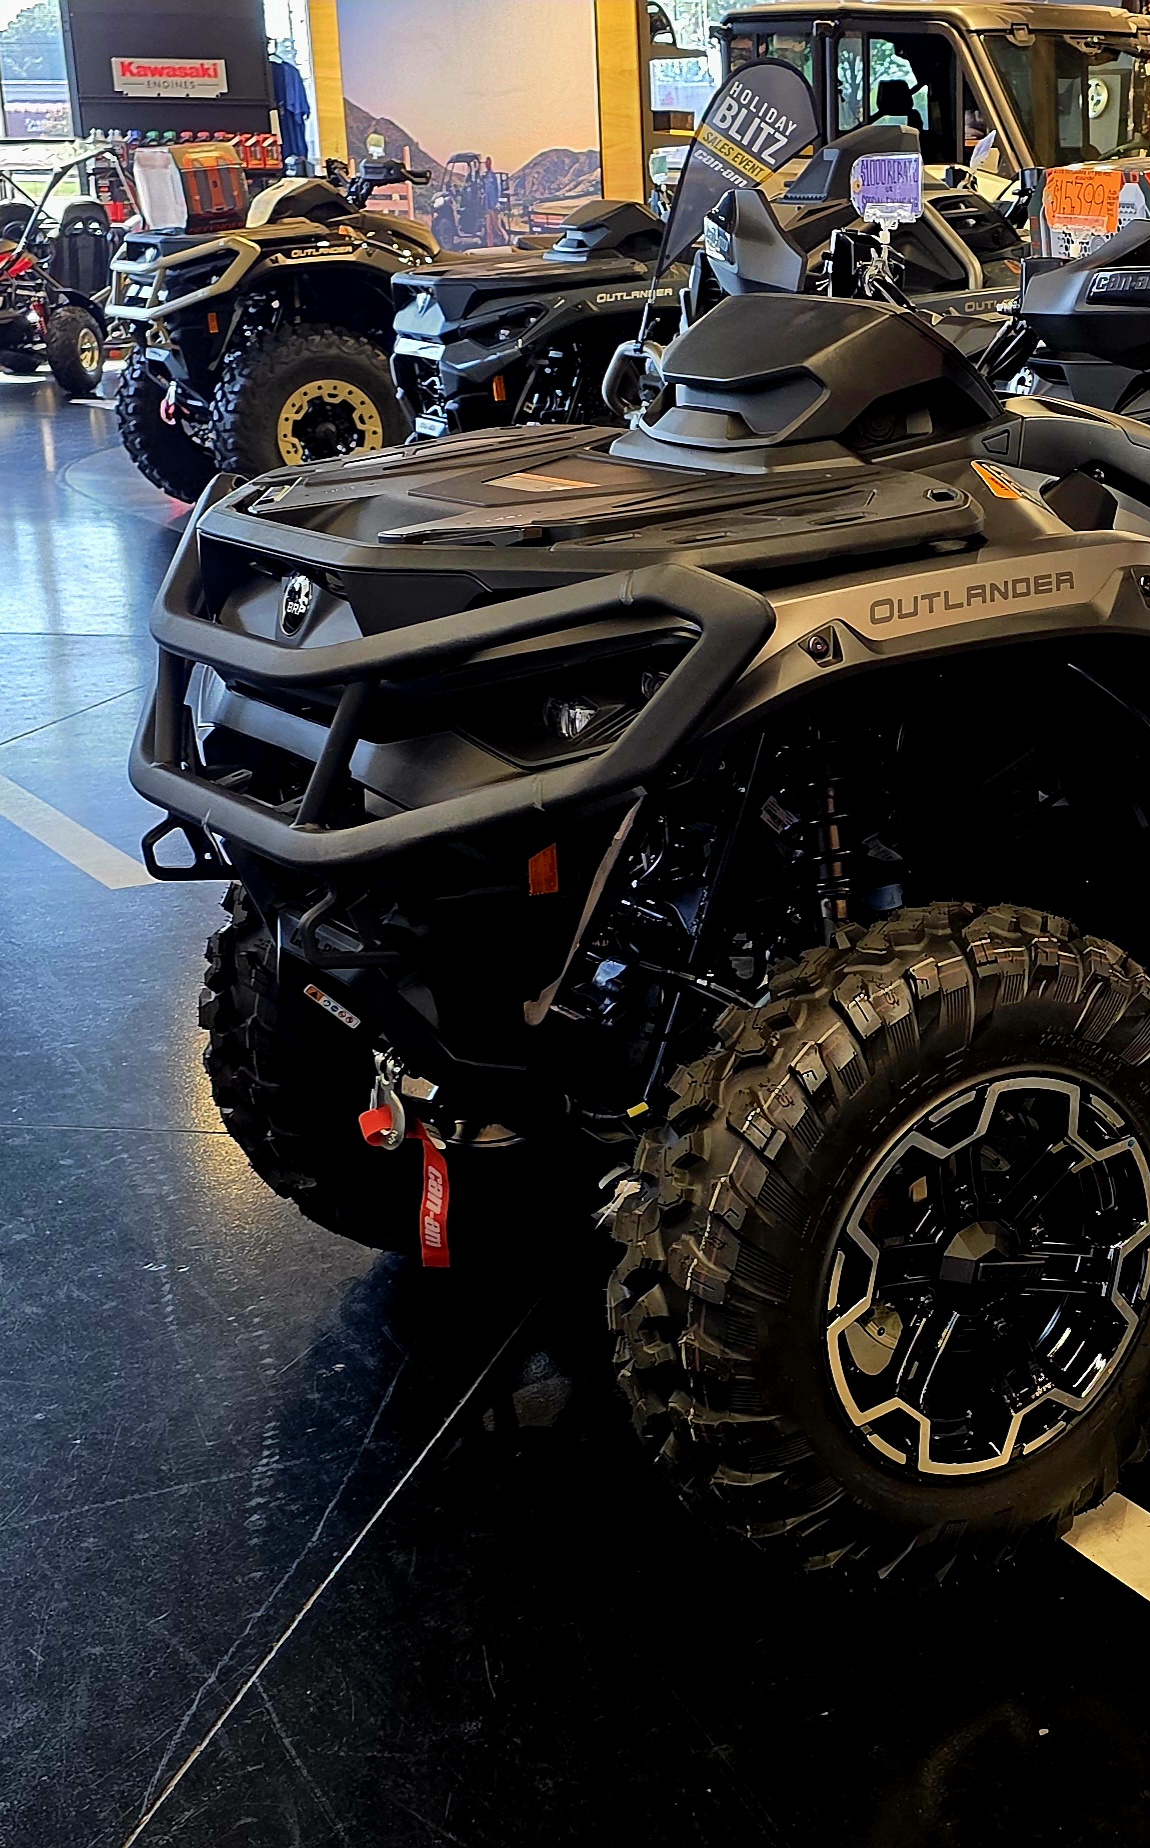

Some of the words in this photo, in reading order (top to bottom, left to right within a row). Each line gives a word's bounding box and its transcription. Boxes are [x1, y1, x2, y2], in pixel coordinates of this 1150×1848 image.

[120, 62, 218, 78] Kawasaki
[712, 96, 788, 165] BLITZ
[729, 81, 797, 136] HOLIDAY
[693, 149, 749, 188] can-am
[702, 132, 735, 157] SALES
[732, 152, 765, 178] EVENT
[291, 245, 353, 258] OUTLANDER
[287, 602, 307, 615] BRP
[869, 571, 1075, 625] OUTLANDER
[424, 1165, 444, 1248] can-am
